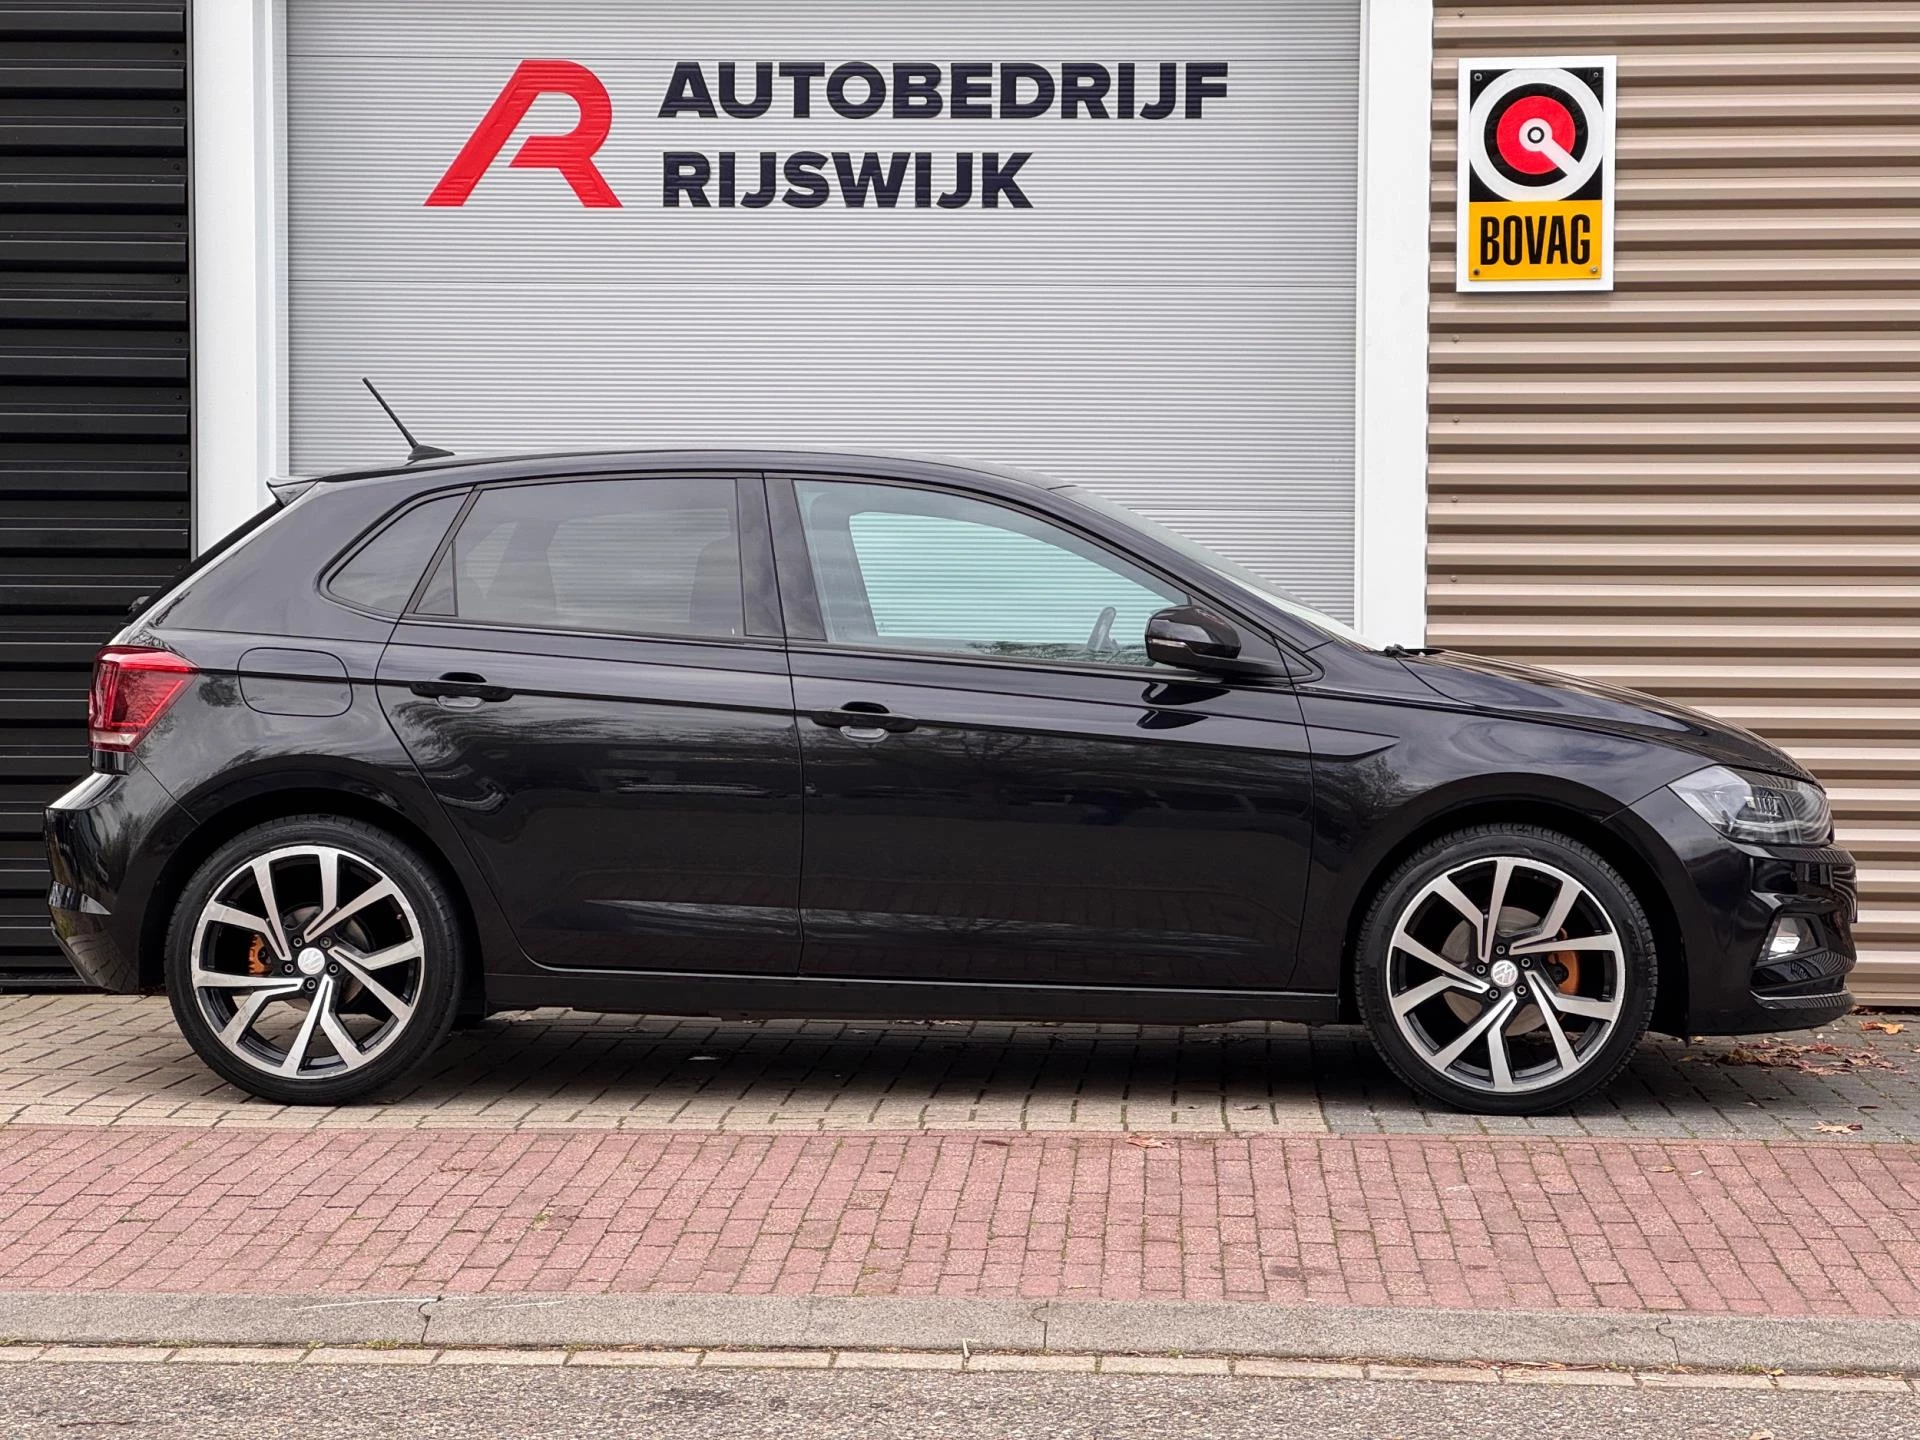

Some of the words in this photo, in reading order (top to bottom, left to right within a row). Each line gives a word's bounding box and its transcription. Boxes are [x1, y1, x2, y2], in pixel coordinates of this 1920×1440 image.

[658, 61, 1229, 119] AUTOBEDRIJF
[424, 59, 622, 208] R
[662, 151, 1033, 209] RIJSWIJK
[1480, 214, 1591, 266] BOVAG
